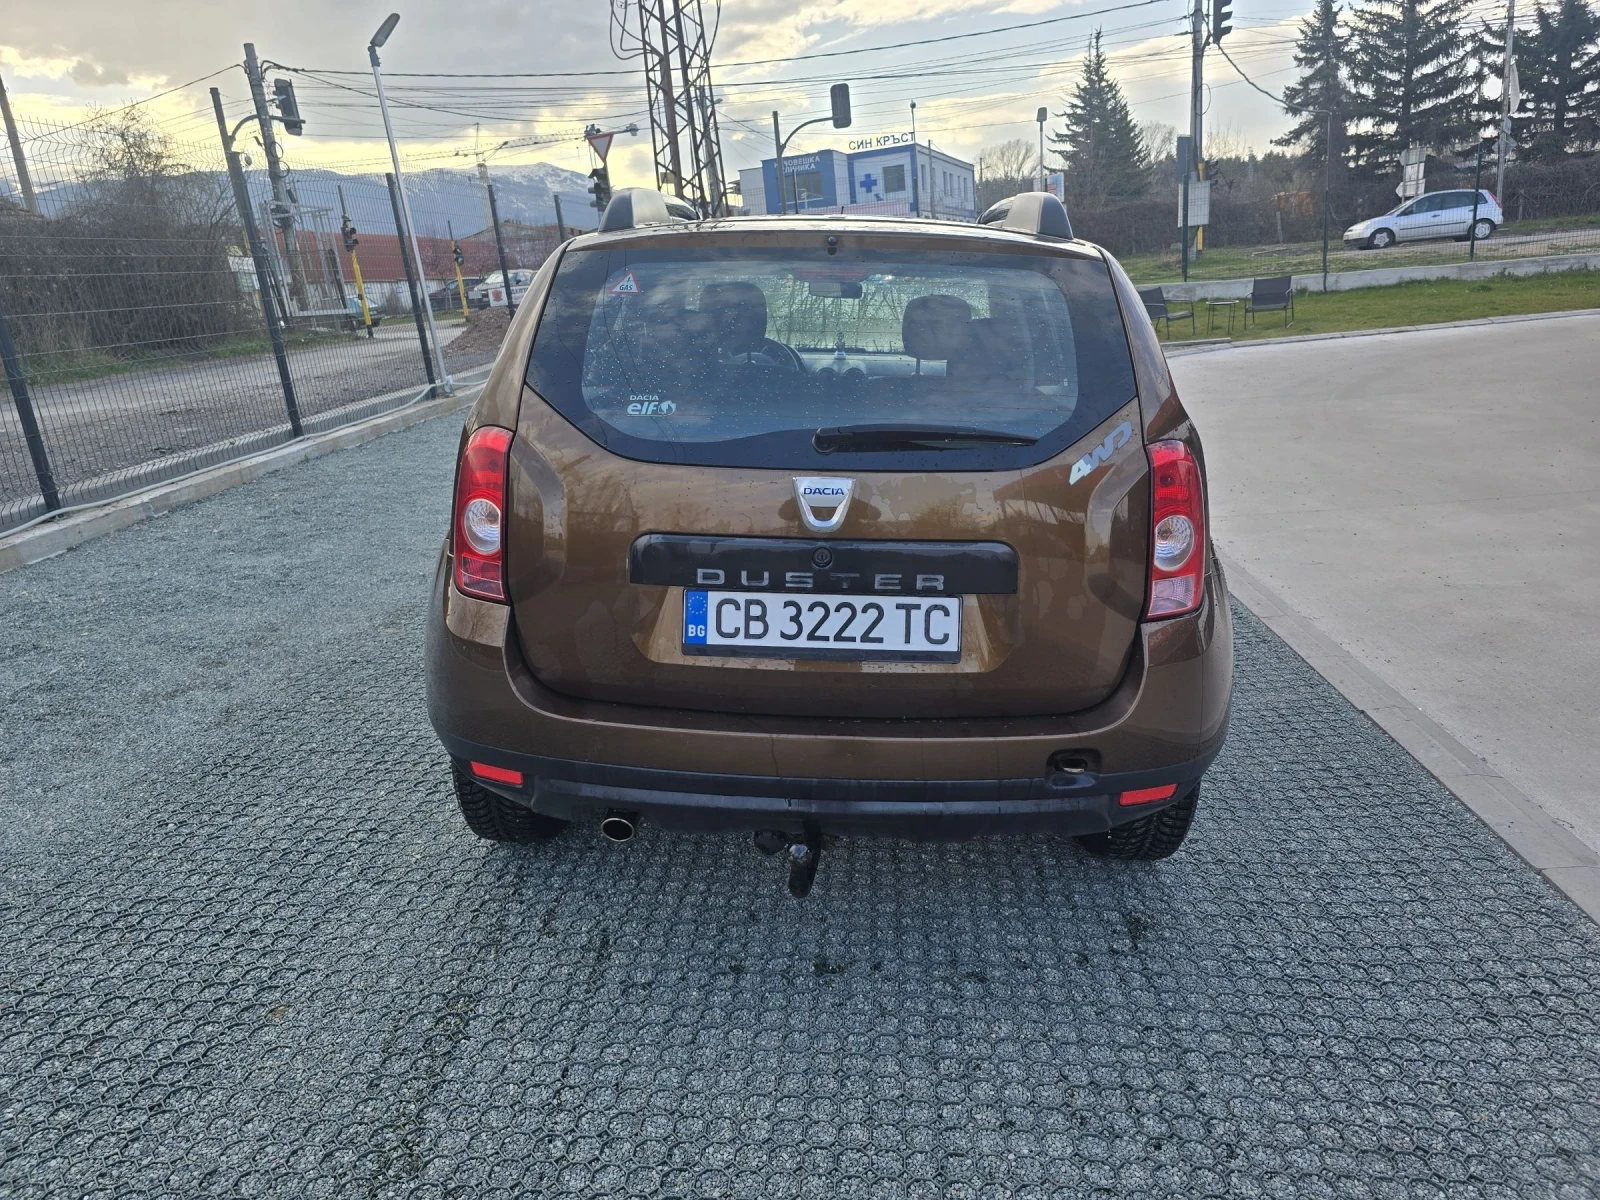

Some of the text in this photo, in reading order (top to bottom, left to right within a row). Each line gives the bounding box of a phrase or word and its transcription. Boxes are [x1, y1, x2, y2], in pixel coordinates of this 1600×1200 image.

[848, 131, 914, 150] СИН КРЪСТ
[774, 156, 820, 168] НЧОВЕШКА
[782, 163, 816, 174] ЛИНИКА
[627, 401, 659, 415] elf
[1069, 421, 1132, 486] 4WD
[803, 487, 845, 496] DACIA
[696, 568, 945, 591] DUSTER
[715, 598, 951, 645] CB 3222 TC
[688, 624, 706, 637] BG
